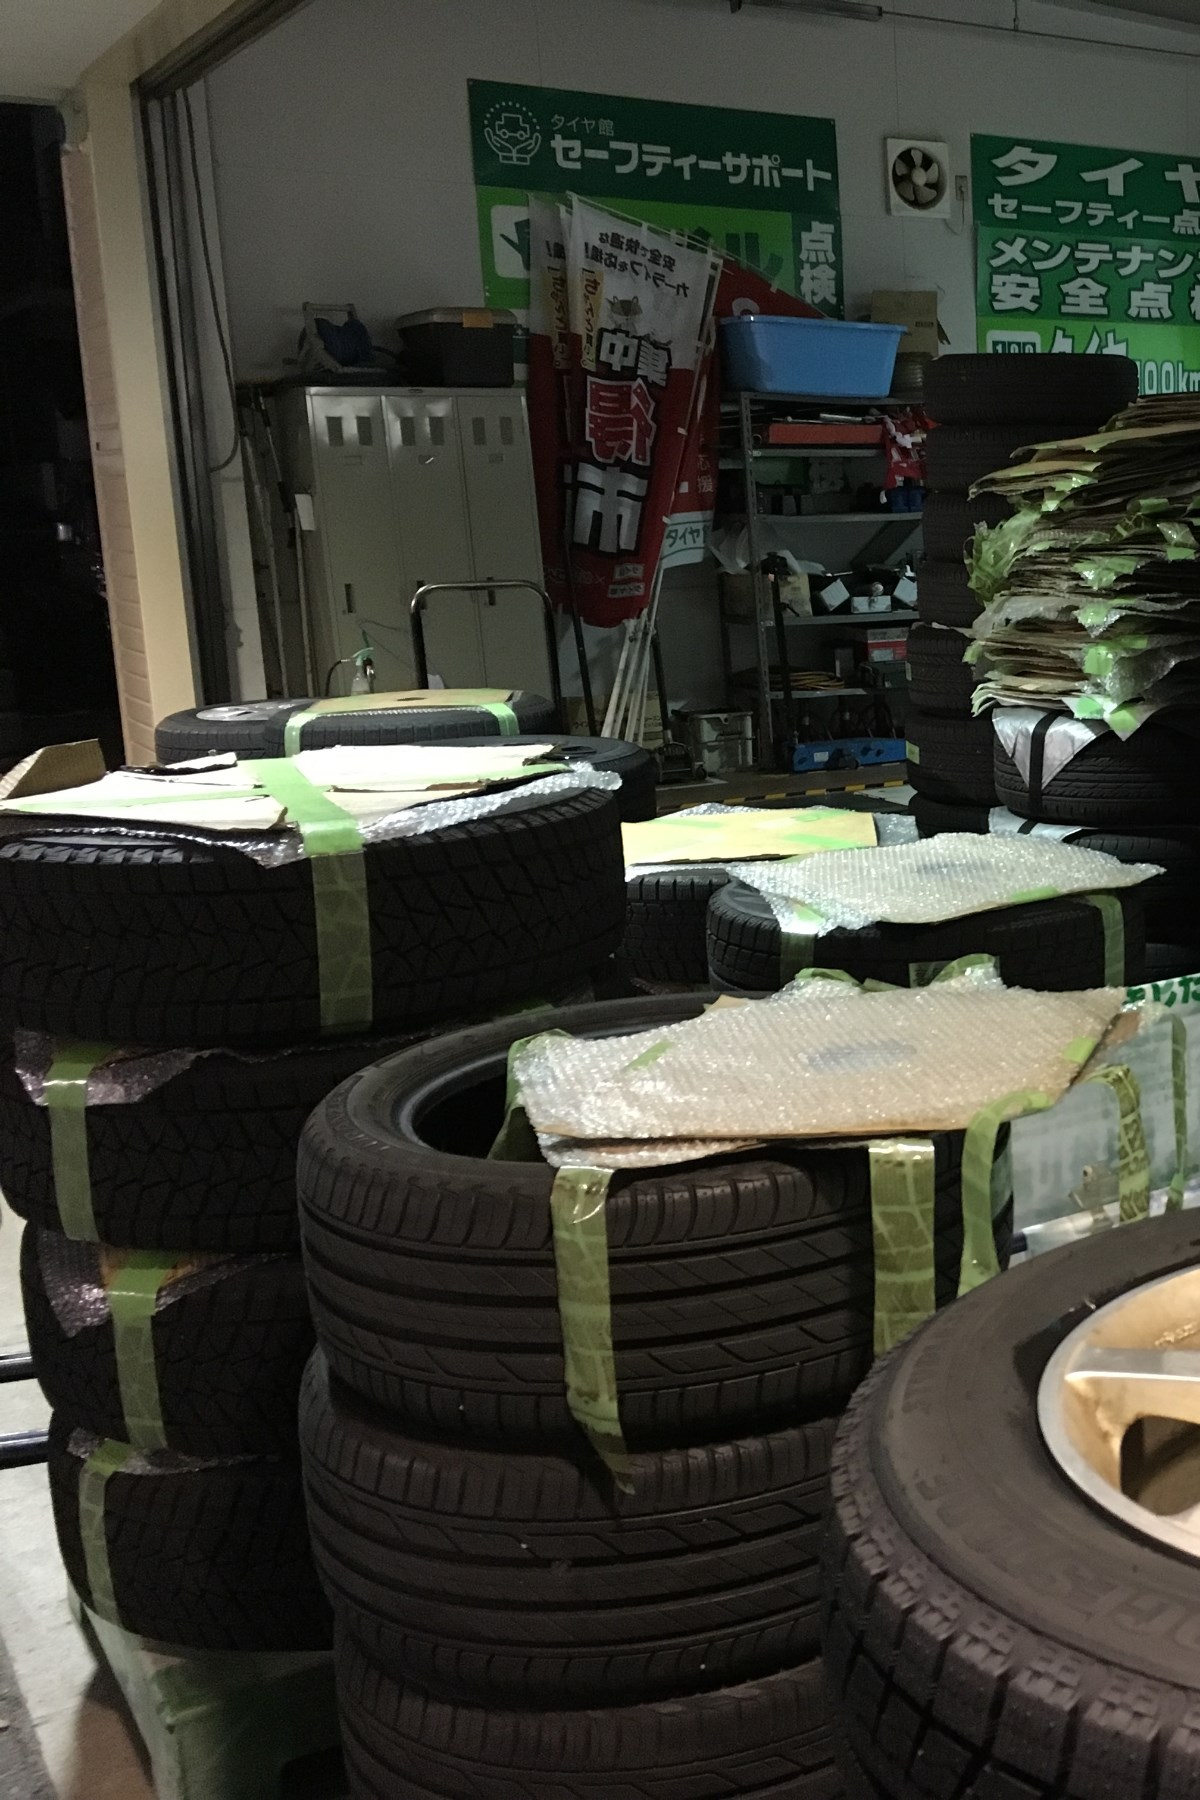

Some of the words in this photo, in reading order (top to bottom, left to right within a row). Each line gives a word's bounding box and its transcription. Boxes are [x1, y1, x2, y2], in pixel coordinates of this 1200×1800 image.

[551, 114, 614, 137] タイヤ館
[550, 133, 832, 191] セーフティーサポート
[800, 221, 836, 305] 点検
